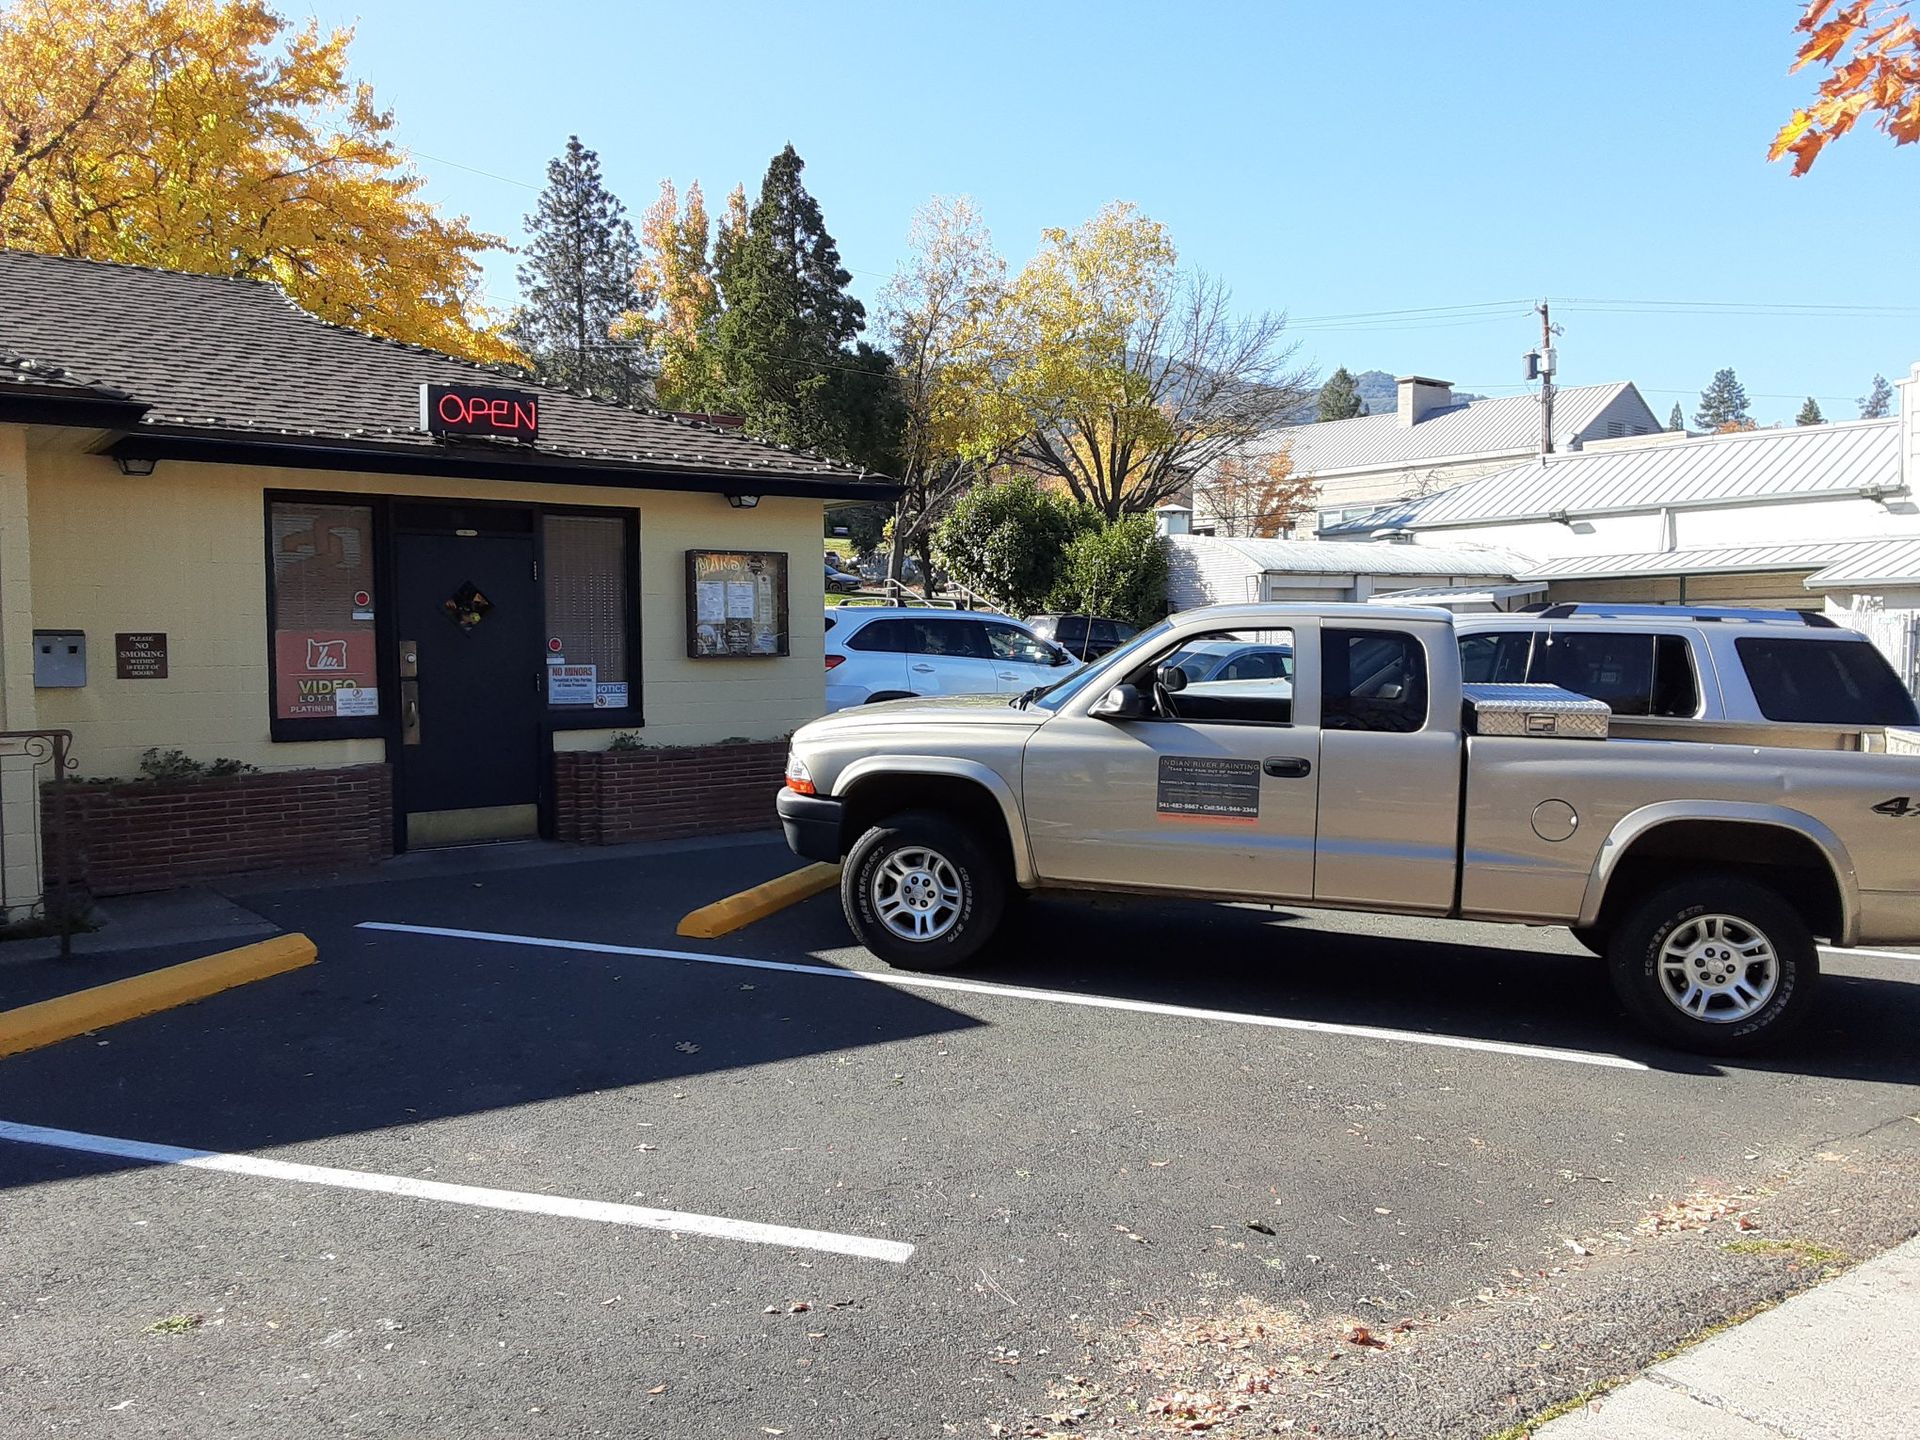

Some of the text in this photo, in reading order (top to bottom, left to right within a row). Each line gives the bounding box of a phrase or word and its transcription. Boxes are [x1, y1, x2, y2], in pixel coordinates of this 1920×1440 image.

[439, 394, 536, 431] OPEN
[120, 650, 164, 658] SMOKING
[552, 667, 592, 676] NO MINORS
[298, 680, 358, 694] VIDEO
[299, 694, 337, 703] LOTT
[290, 704, 334, 713] PLATINUM
[1160, 759, 1260, 770] INDIAN RIVER PAINTING
[858, 846, 885, 924] MASTERCRAFT
